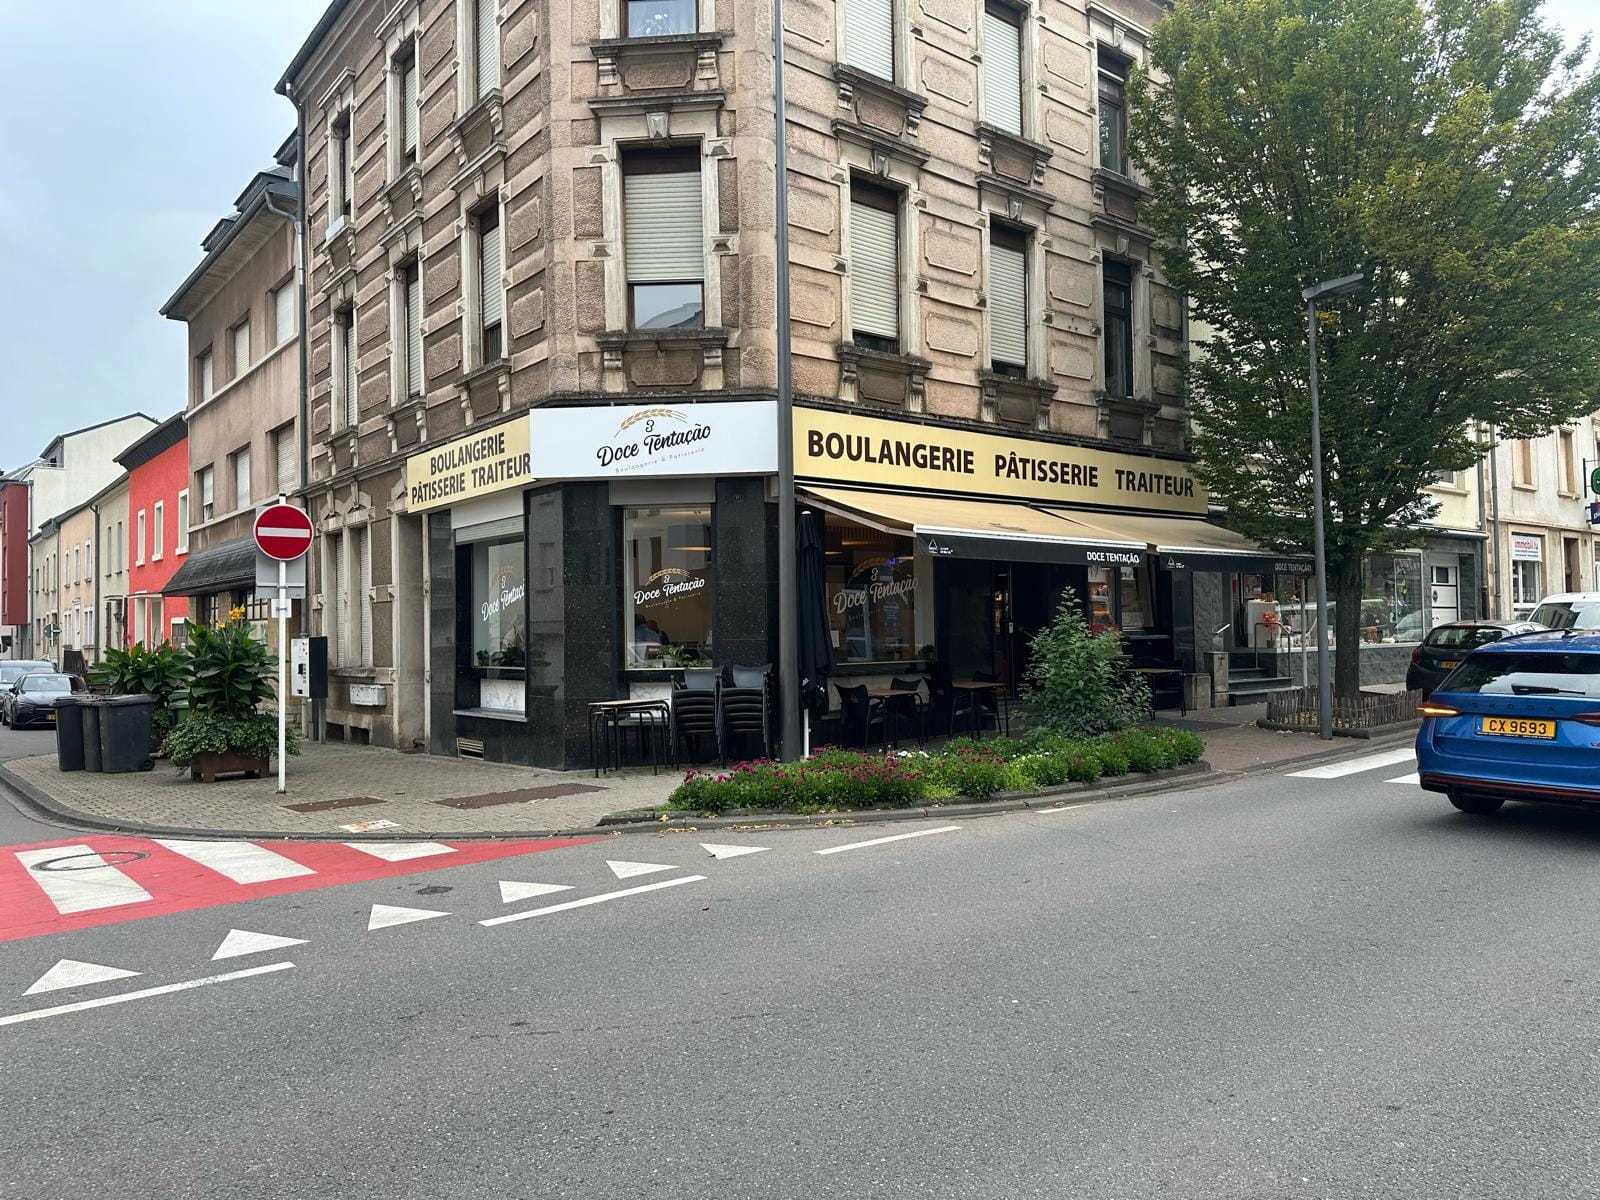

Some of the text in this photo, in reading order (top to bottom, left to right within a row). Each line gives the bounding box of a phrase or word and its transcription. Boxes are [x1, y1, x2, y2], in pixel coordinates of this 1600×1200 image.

[430, 431, 505, 476] BOULANGERIE
[596, 423, 711, 467] Doce Tentação
[807, 429, 1194, 498] BOULANGERIE PÂTISSERIE TRAITEUR
[411, 452, 531, 505] PÂTISSERIE TRAITEUR
[1086, 551, 1140, 565] DOCE TENTAÇÃO
[481, 598, 500, 621] Doce
[633, 589, 661, 605] Doce
[662, 577, 705, 597] Tentação
[833, 574, 919, 614] Doce Tentação
[1489, 719, 1547, 735] CX 9693
